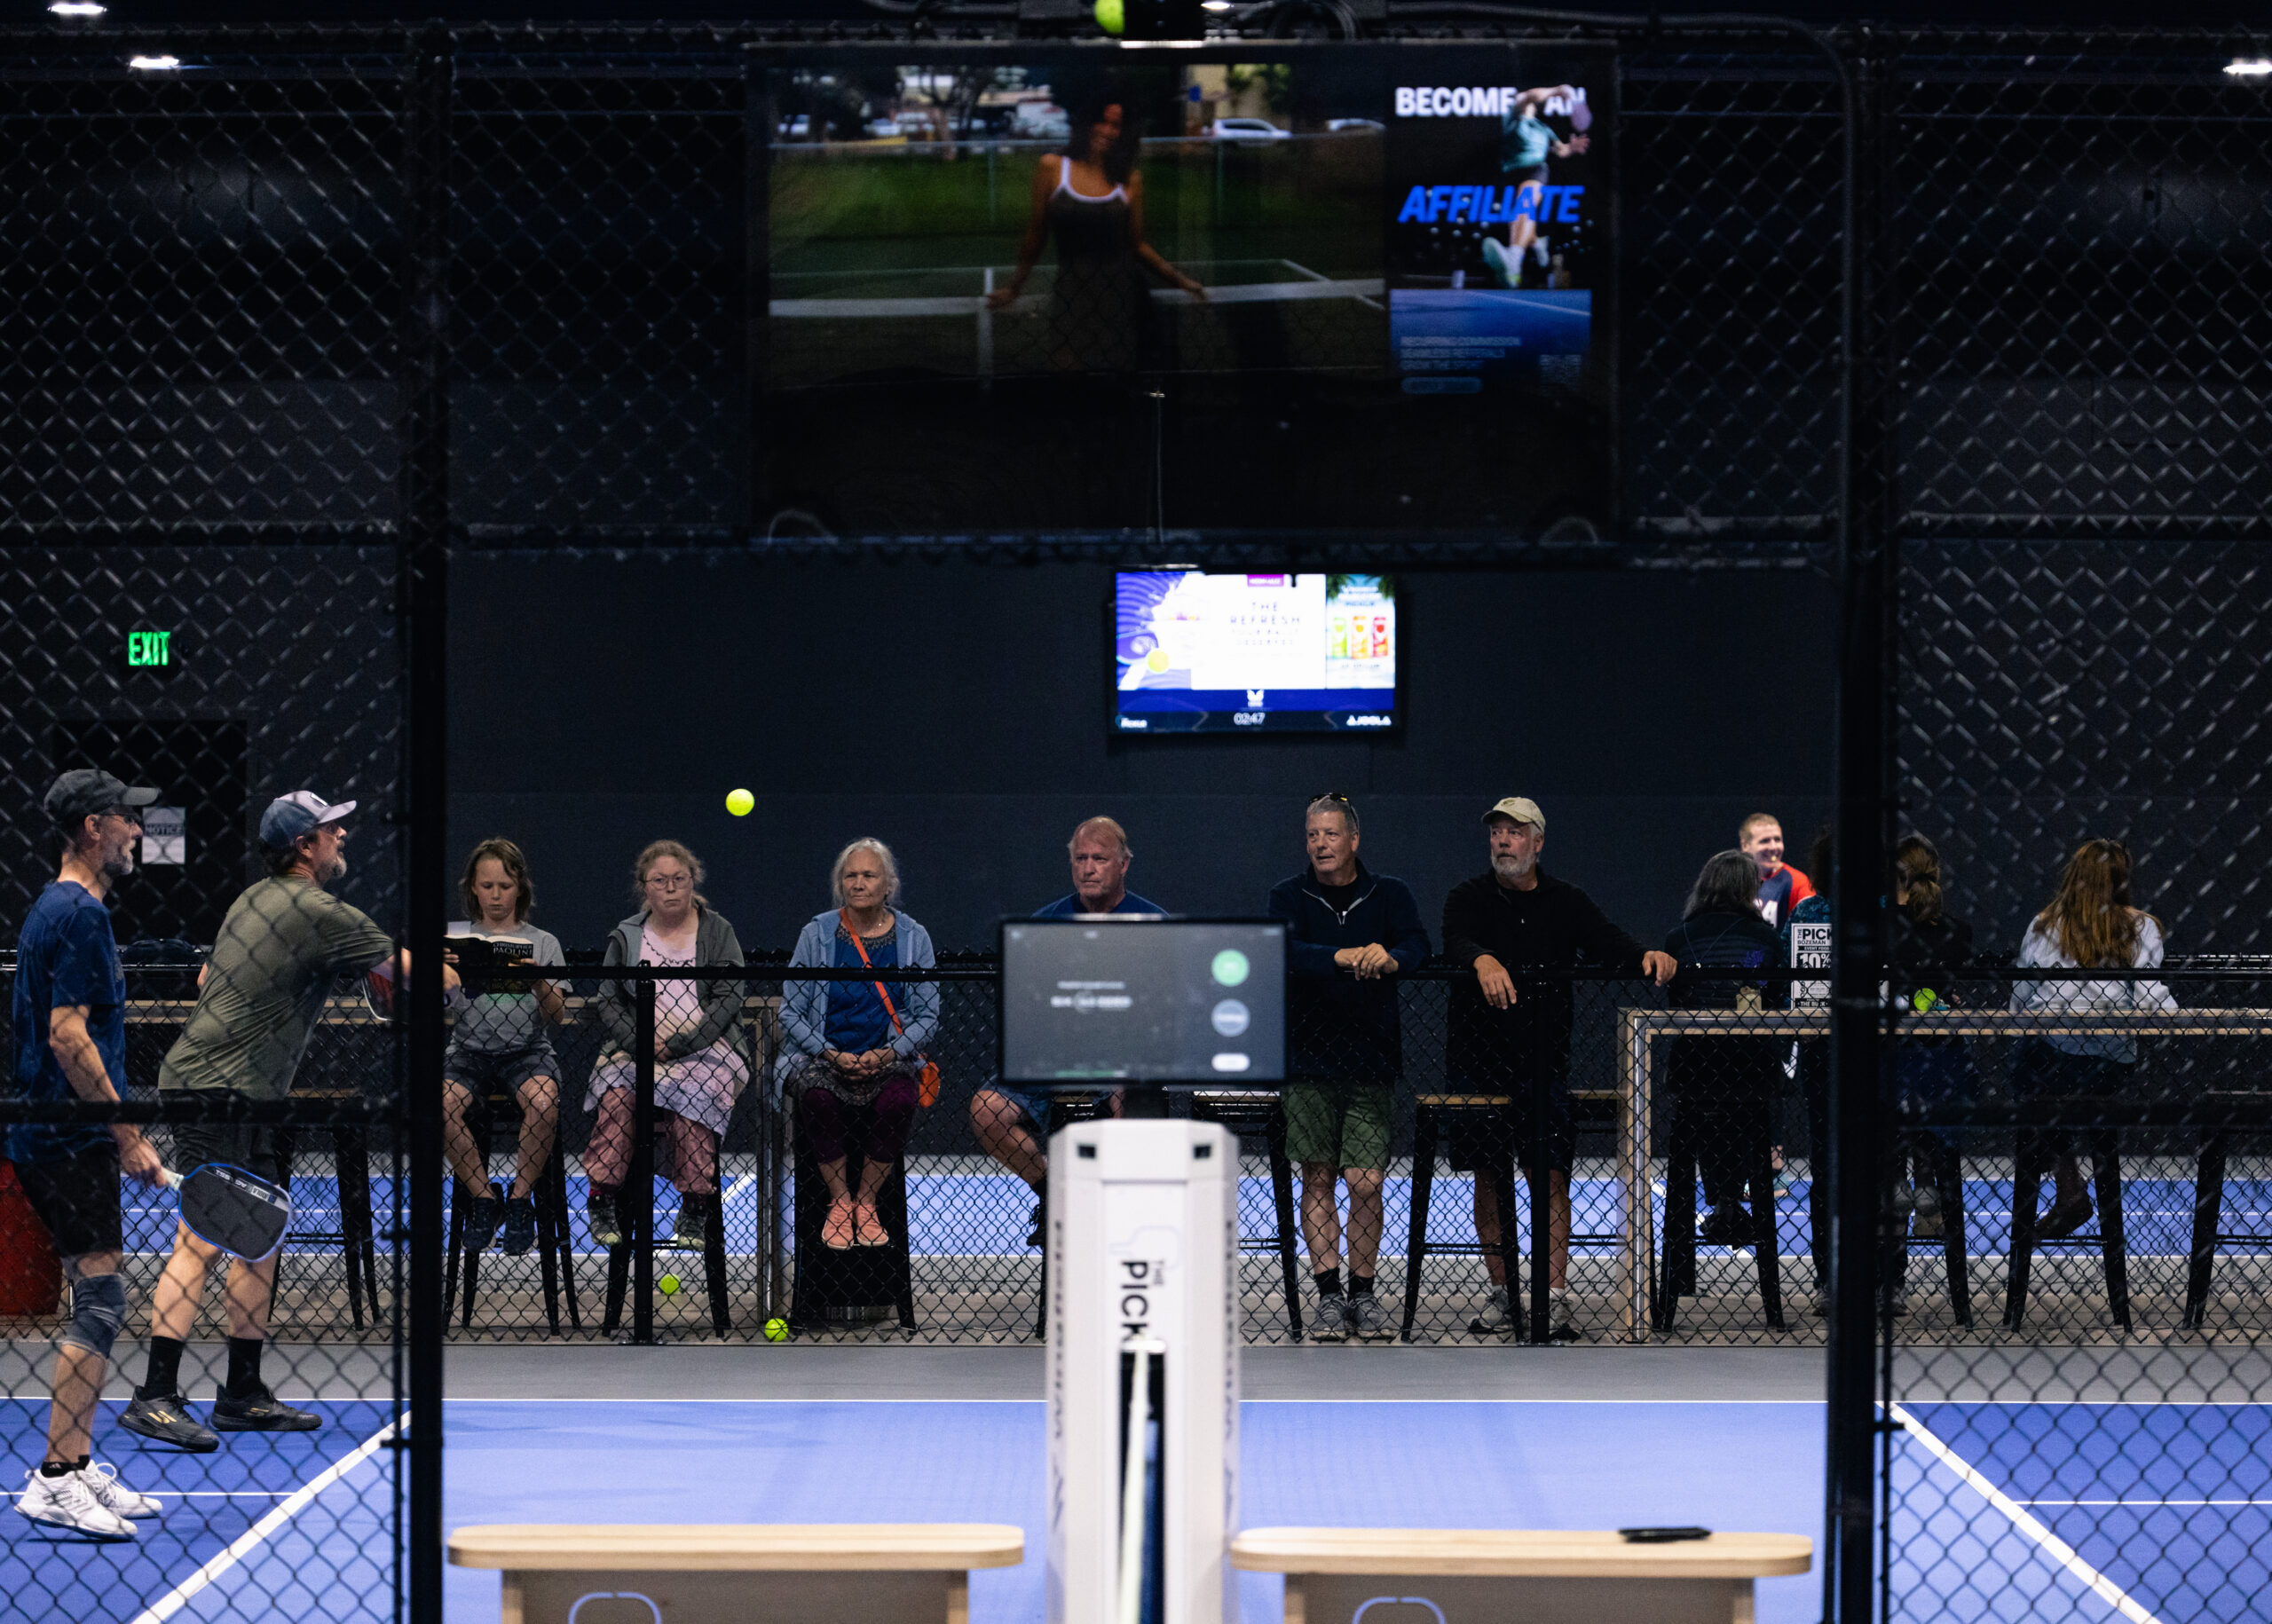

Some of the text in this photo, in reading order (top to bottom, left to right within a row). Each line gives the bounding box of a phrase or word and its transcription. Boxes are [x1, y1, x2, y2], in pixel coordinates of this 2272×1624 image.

[1395, 87, 1518, 116] BECOME
[1397, 185, 1585, 223] AFFILIATE
[128, 631, 171, 666] EXIT
[145, 824, 184, 835] NOTICE
[1153, 1259, 1164, 1287] THE
